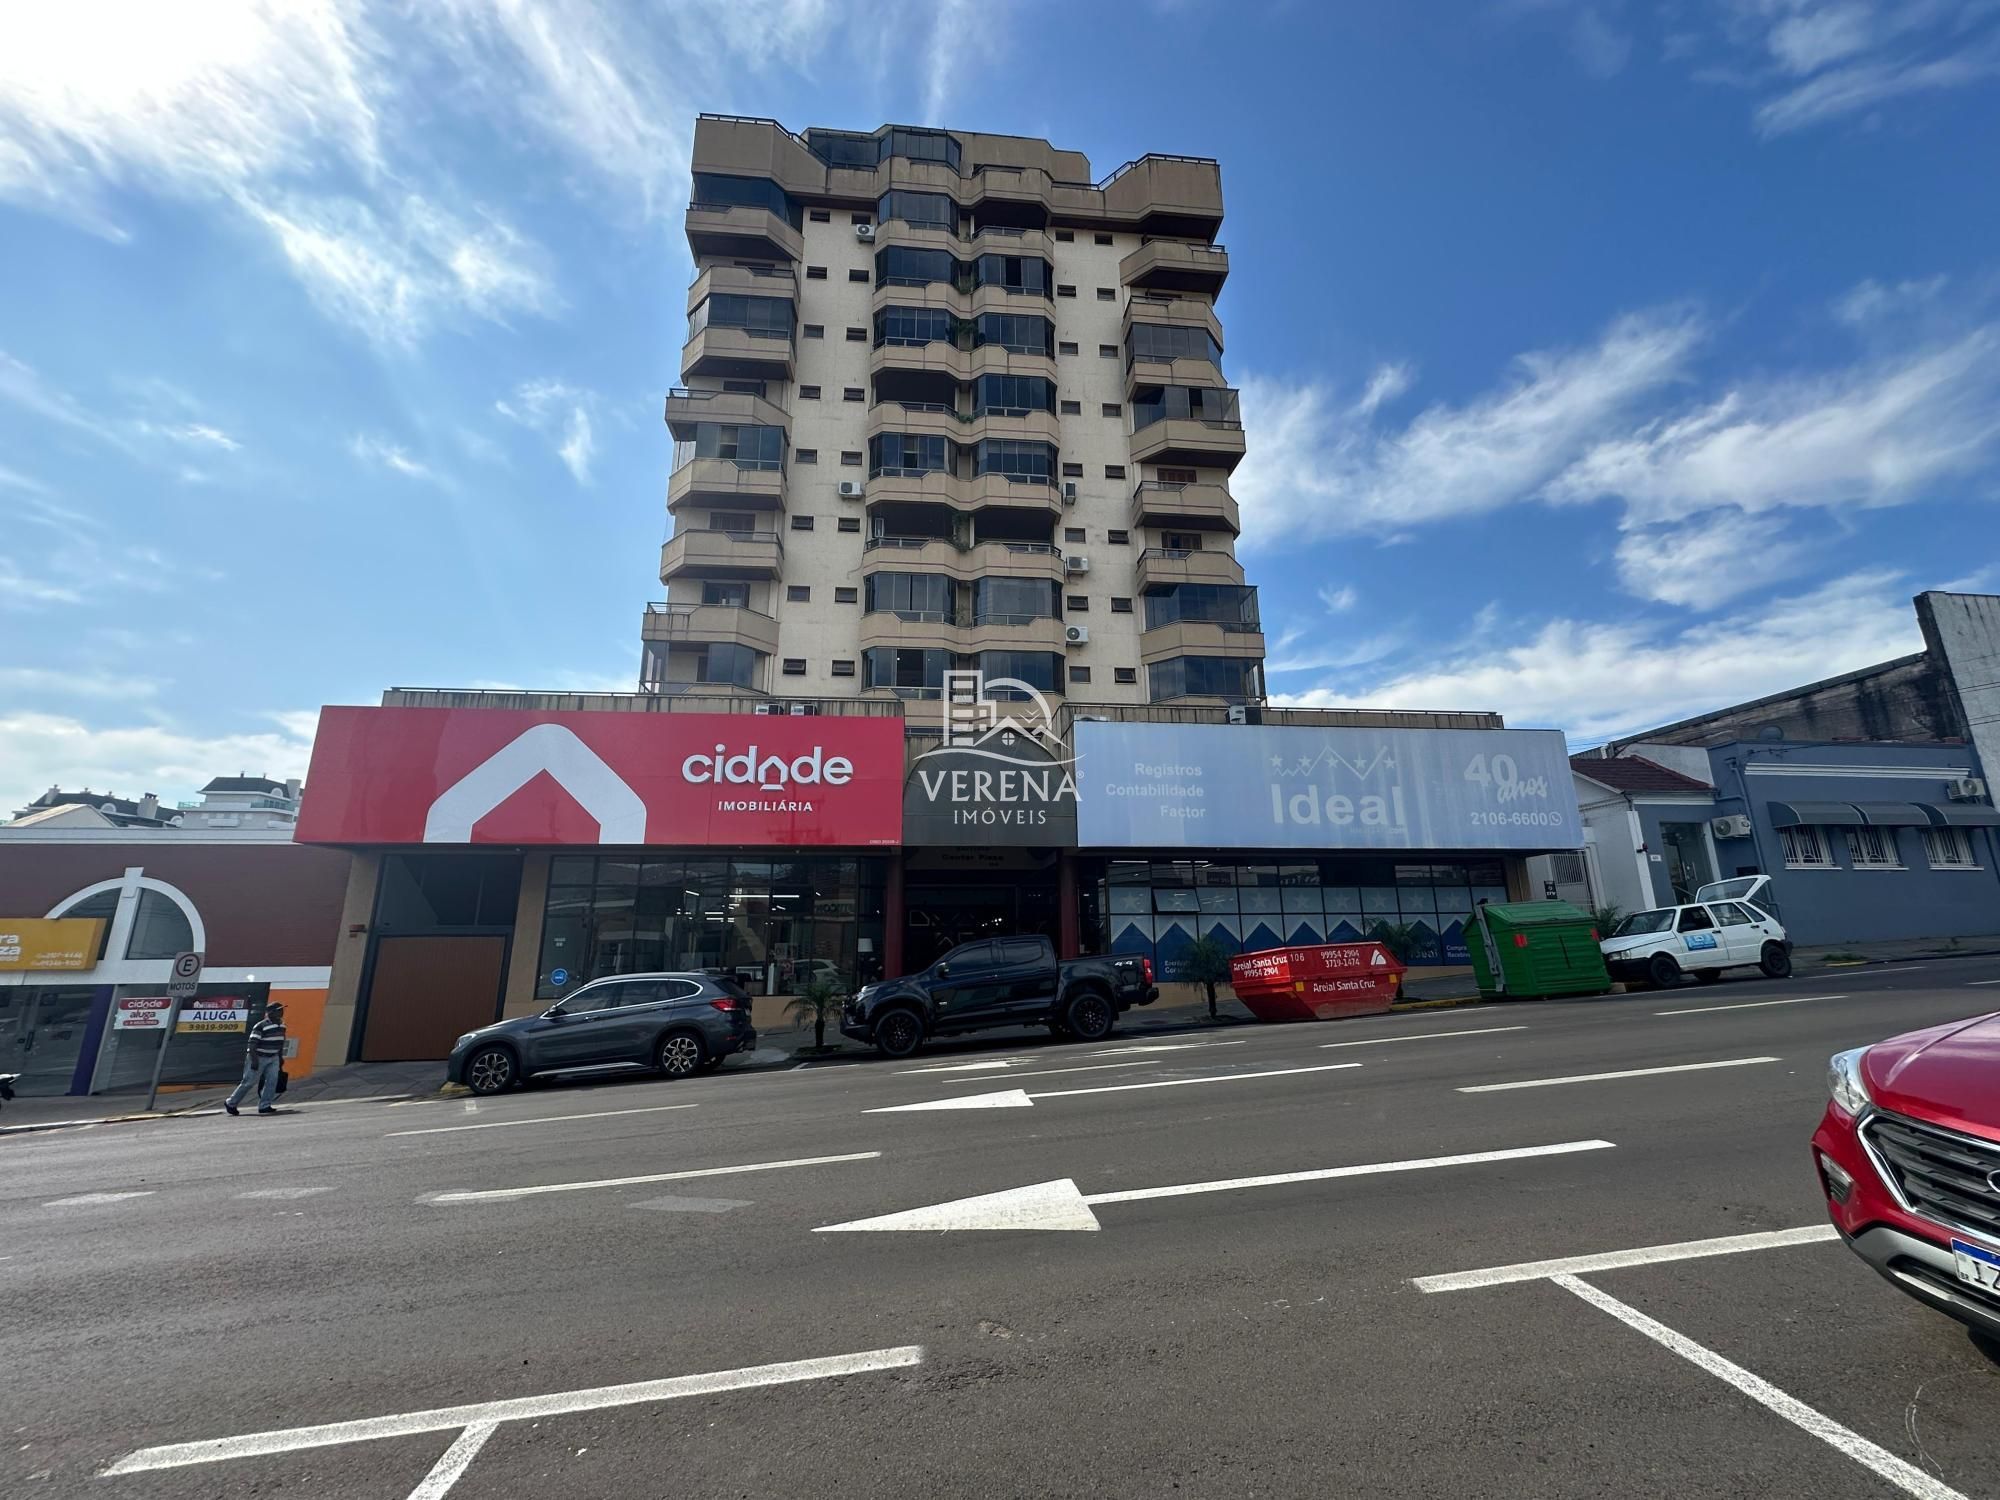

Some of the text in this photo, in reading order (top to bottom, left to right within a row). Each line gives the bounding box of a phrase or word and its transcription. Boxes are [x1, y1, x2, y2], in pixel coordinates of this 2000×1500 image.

[1135, 763, 1202, 778] Registros
[1464, 753, 1517, 787] 40
[1105, 784, 1204, 797] Contabilidade
[1497, 776, 1548, 804] anos
[718, 799, 813, 812] IMOBILIÁRIA
[1271, 784, 1405, 825] Ideal
[1160, 805, 1206, 818] Factor
[1470, 811, 1547, 825] 2106-6600
[1290, 953, 1305, 962] 106
[1320, 949, 1360, 960] 99954 2904
[183, 960, 193, 972] E
[1252, 956, 1272, 968] Santa
[1271, 955, 1288, 965] Cruz
[1243, 967, 1279, 978] 99954 2904
[169, 982, 196, 991] MOTOS
[1313, 979, 1376, 993] Areial Santa Cruz
[129, 1009, 156, 1021] aluga
[193, 1011, 237, 1021] ALUGA
